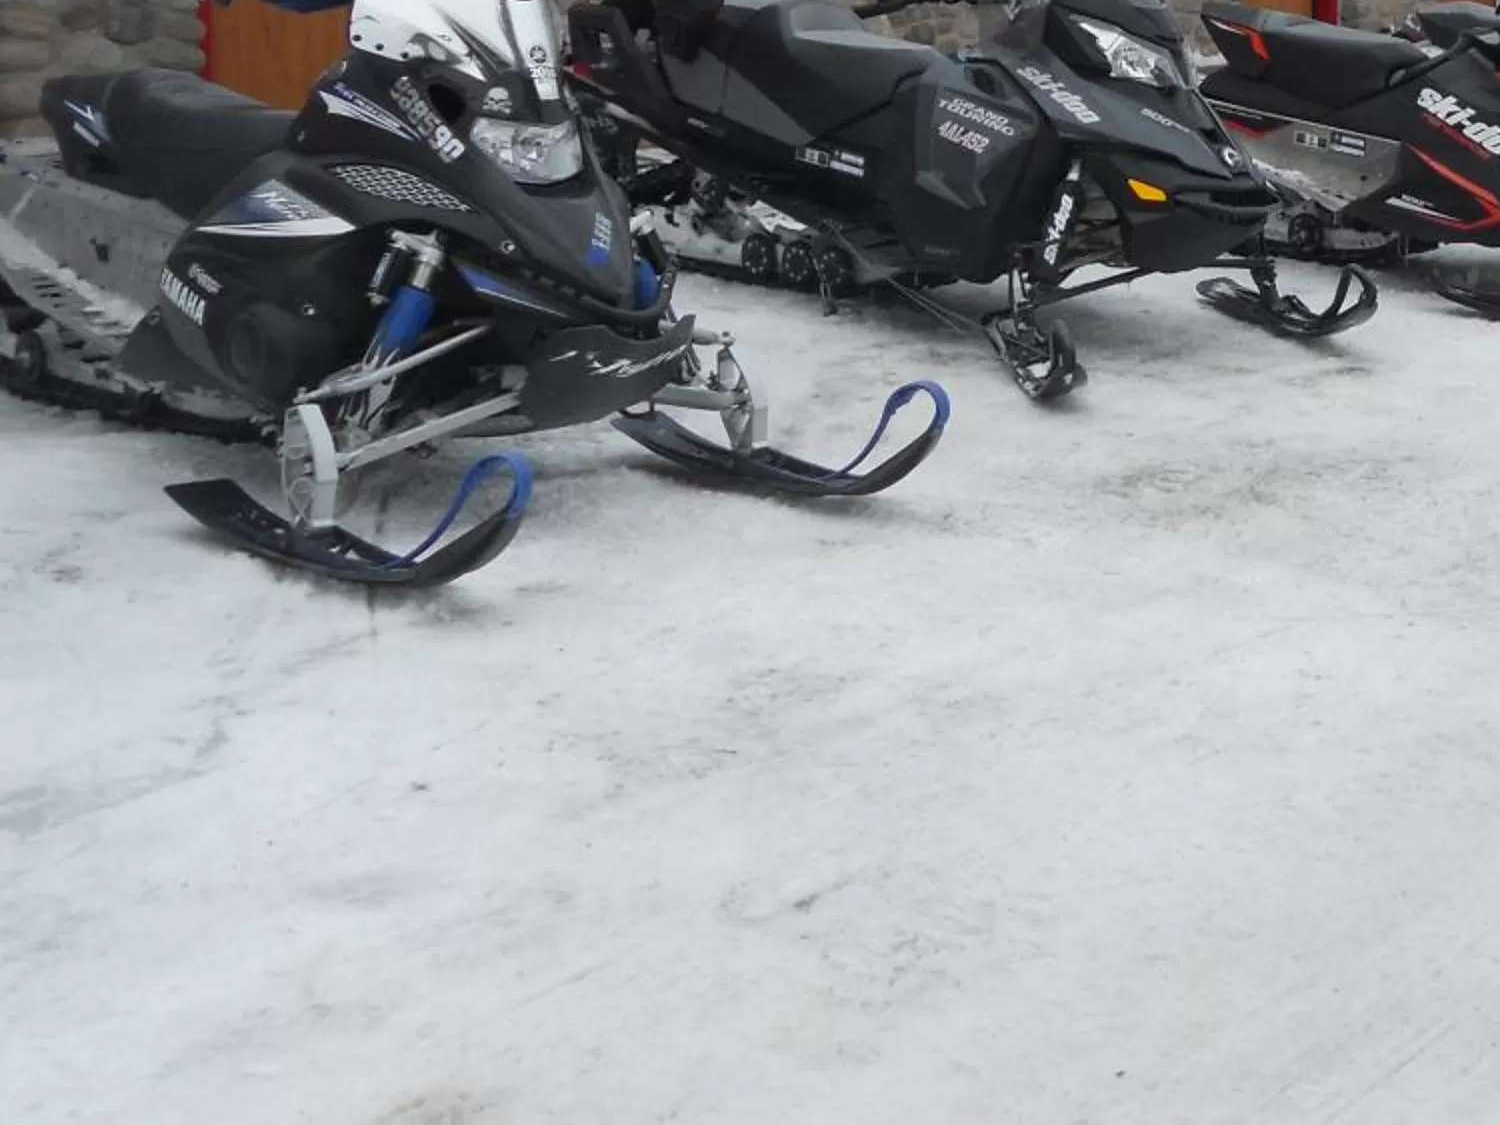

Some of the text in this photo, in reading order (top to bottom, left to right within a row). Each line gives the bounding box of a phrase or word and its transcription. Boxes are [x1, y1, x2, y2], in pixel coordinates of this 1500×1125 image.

[939, 99, 1015, 137] TOURING
[953, 97, 1009, 125] GRAND
[160, 267, 207, 327] YAMAHA
